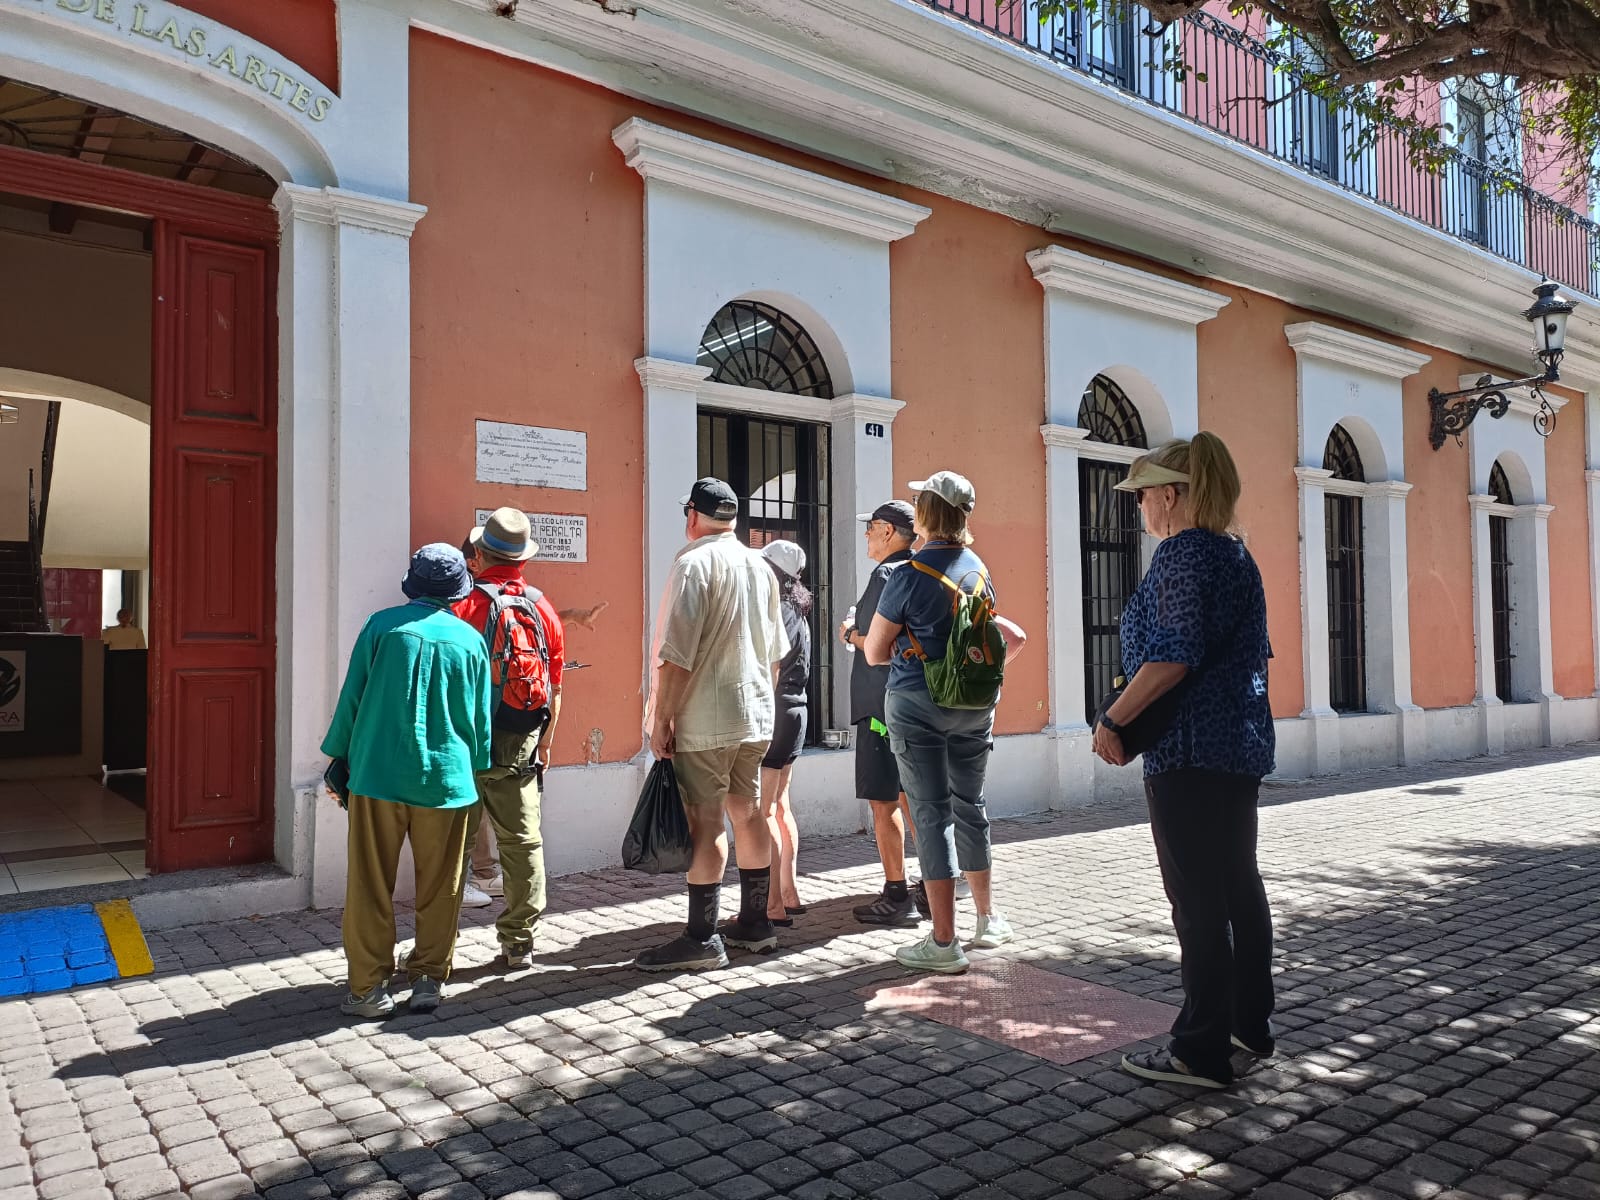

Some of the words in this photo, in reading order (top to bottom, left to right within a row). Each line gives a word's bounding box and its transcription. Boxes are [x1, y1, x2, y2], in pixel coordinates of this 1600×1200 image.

[130, 3, 207, 58] LAS
[209, 45, 333, 122] ARTES
[868, 424, 879, 438] 41
[540, 525, 582, 539] PERALTA
